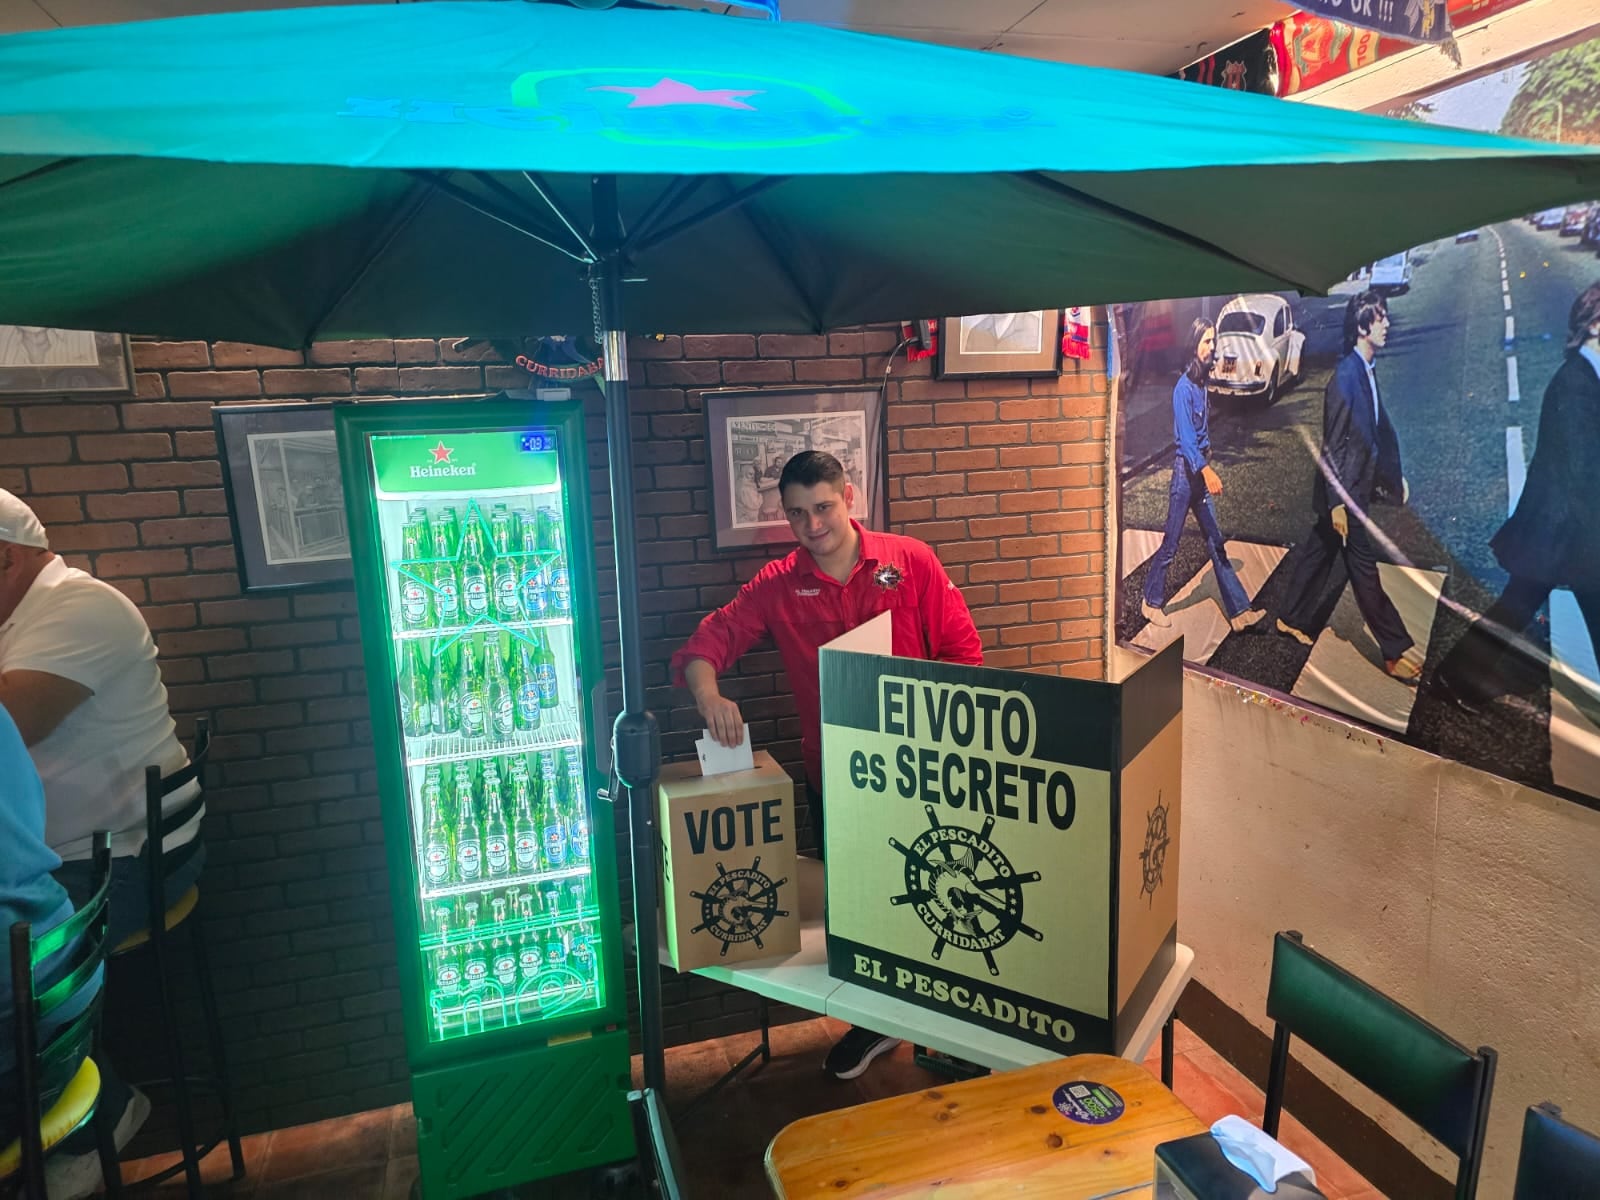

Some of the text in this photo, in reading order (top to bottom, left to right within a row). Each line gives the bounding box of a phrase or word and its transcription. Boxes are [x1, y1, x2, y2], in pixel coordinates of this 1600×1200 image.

[515, 355, 604, 379] CURRIDABA
[409, 464, 476, 478] Heineken
[883, 679, 1030, 757] El VOTO
[849, 744, 1076, 831] es SECRETO
[684, 798, 784, 855] VOTE
[913, 828, 1011, 878] EL PESCADITO
[720, 870, 770, 889] PESCADITO
[709, 919, 768, 942] CURRIDABAT
[916, 902, 1006, 950] CURRIDABAT
[853, 952, 1076, 1043] EL PESCADITO
